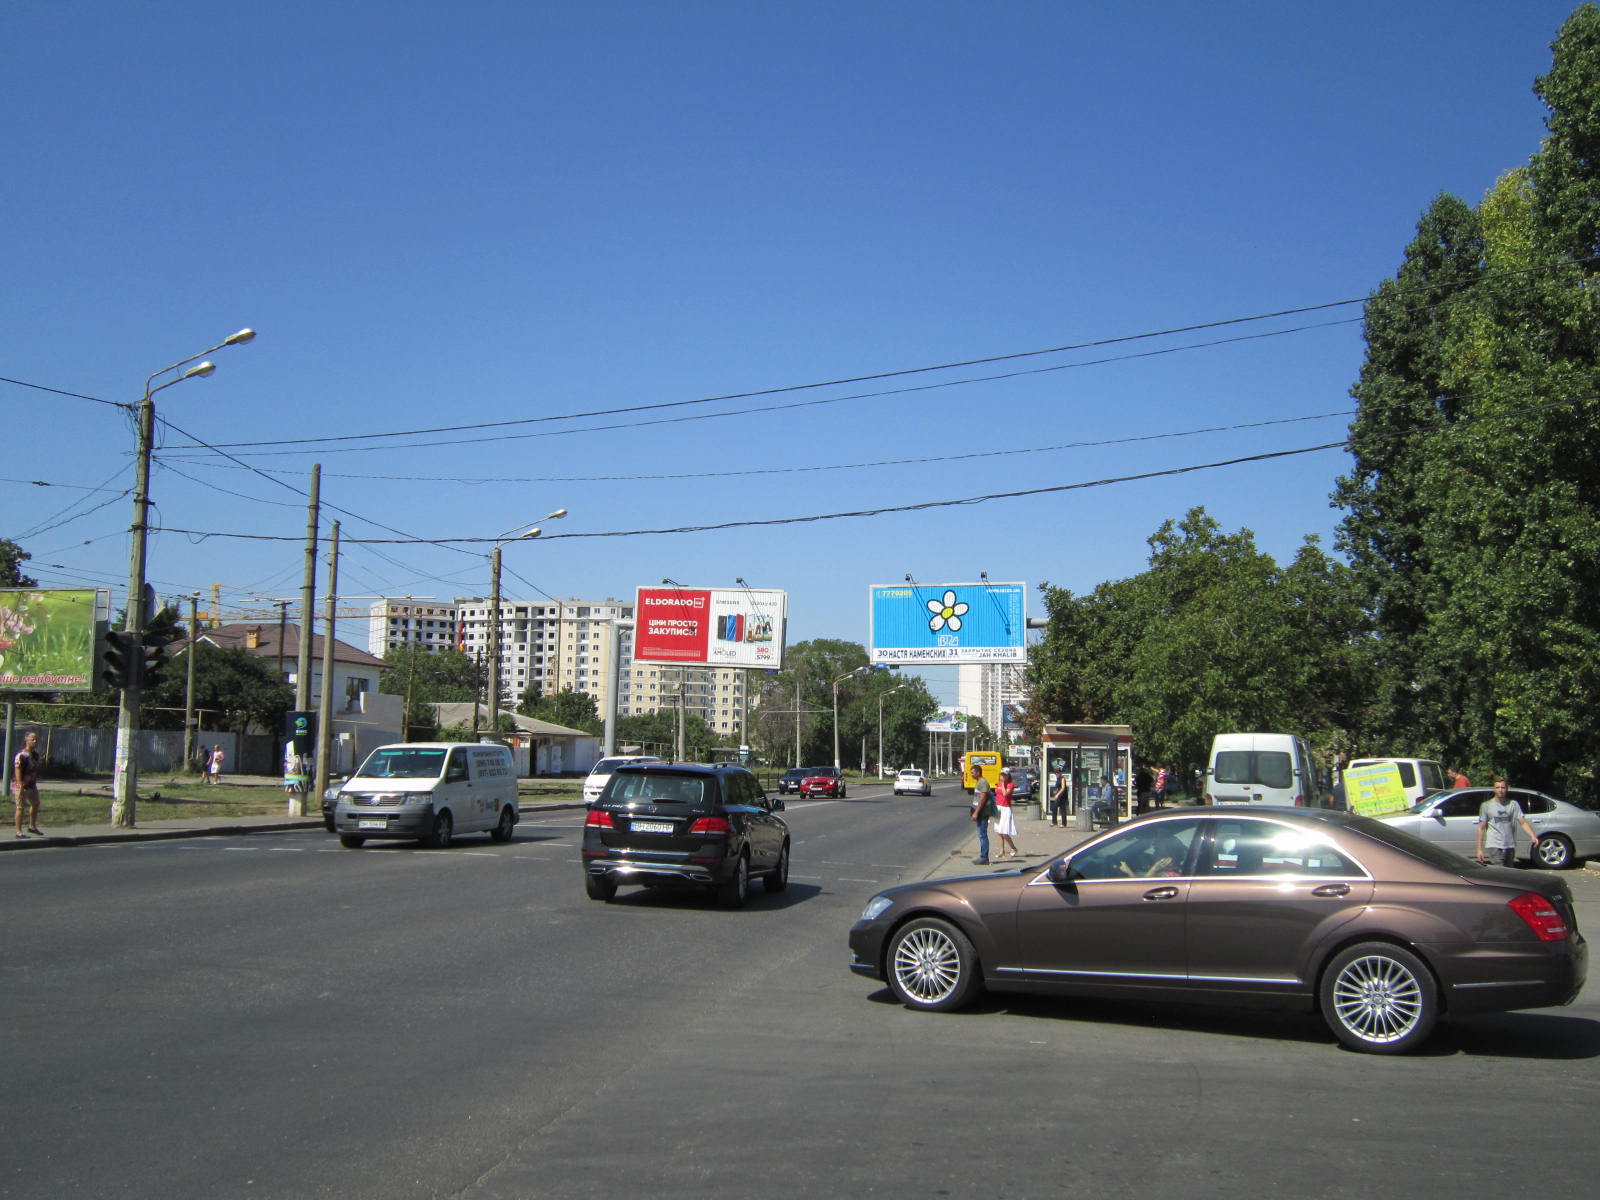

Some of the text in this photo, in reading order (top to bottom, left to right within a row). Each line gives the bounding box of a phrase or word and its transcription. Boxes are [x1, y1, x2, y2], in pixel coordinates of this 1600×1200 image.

[645, 598, 693, 606] ELDORADO
[649, 619, 698, 628] ЦІНИ ПРОСТО
[889, 650, 908, 660] НАСТЯ
